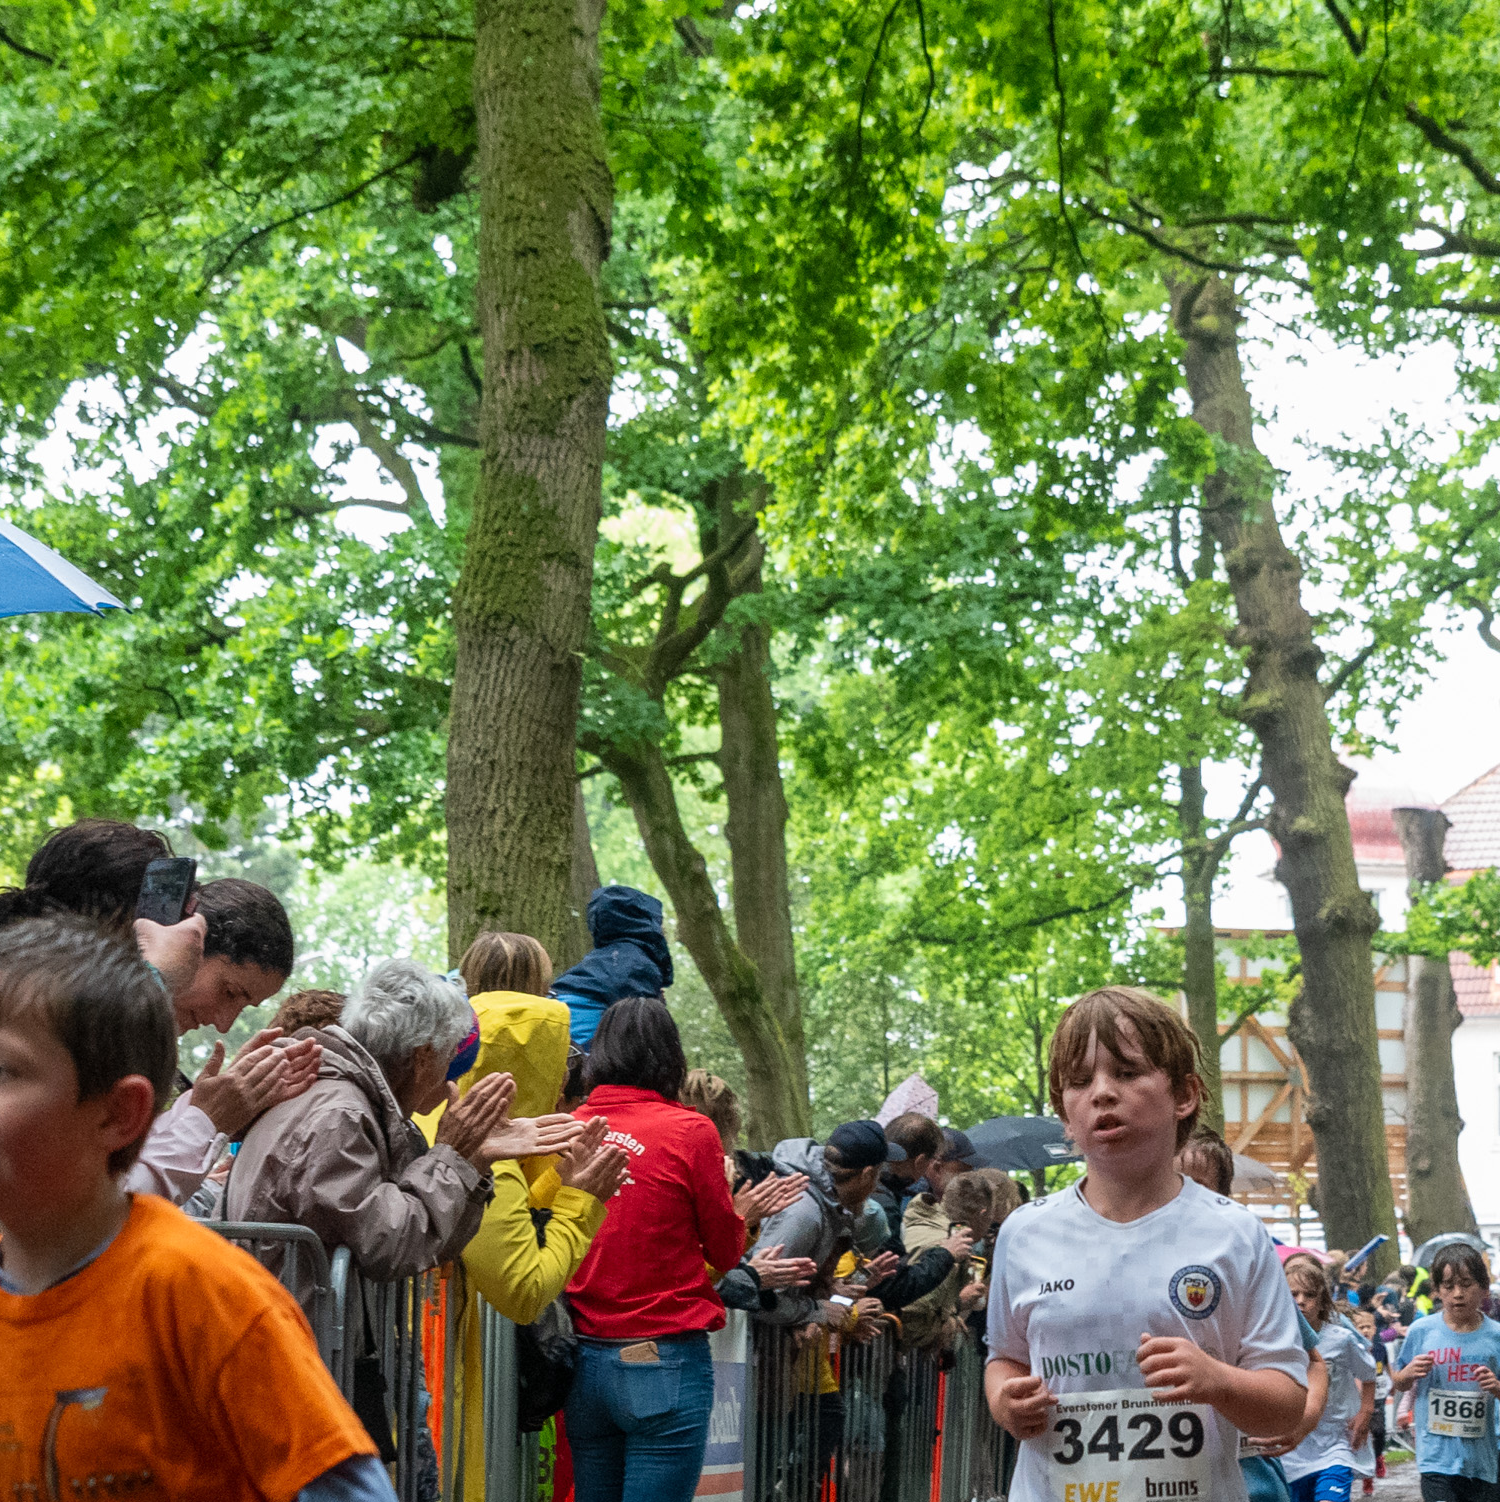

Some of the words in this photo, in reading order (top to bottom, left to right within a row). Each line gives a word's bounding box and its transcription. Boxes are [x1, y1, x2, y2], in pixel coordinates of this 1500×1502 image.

[603, 1130, 646, 1157] ersten
[1038, 1278, 1076, 1296] JAKO
[1183, 1277, 1210, 1288] PSV
[1430, 1398, 1485, 1419] 1868
[1052, 1411, 1205, 1465] 3429
[1145, 1476, 1198, 1498] bruns
